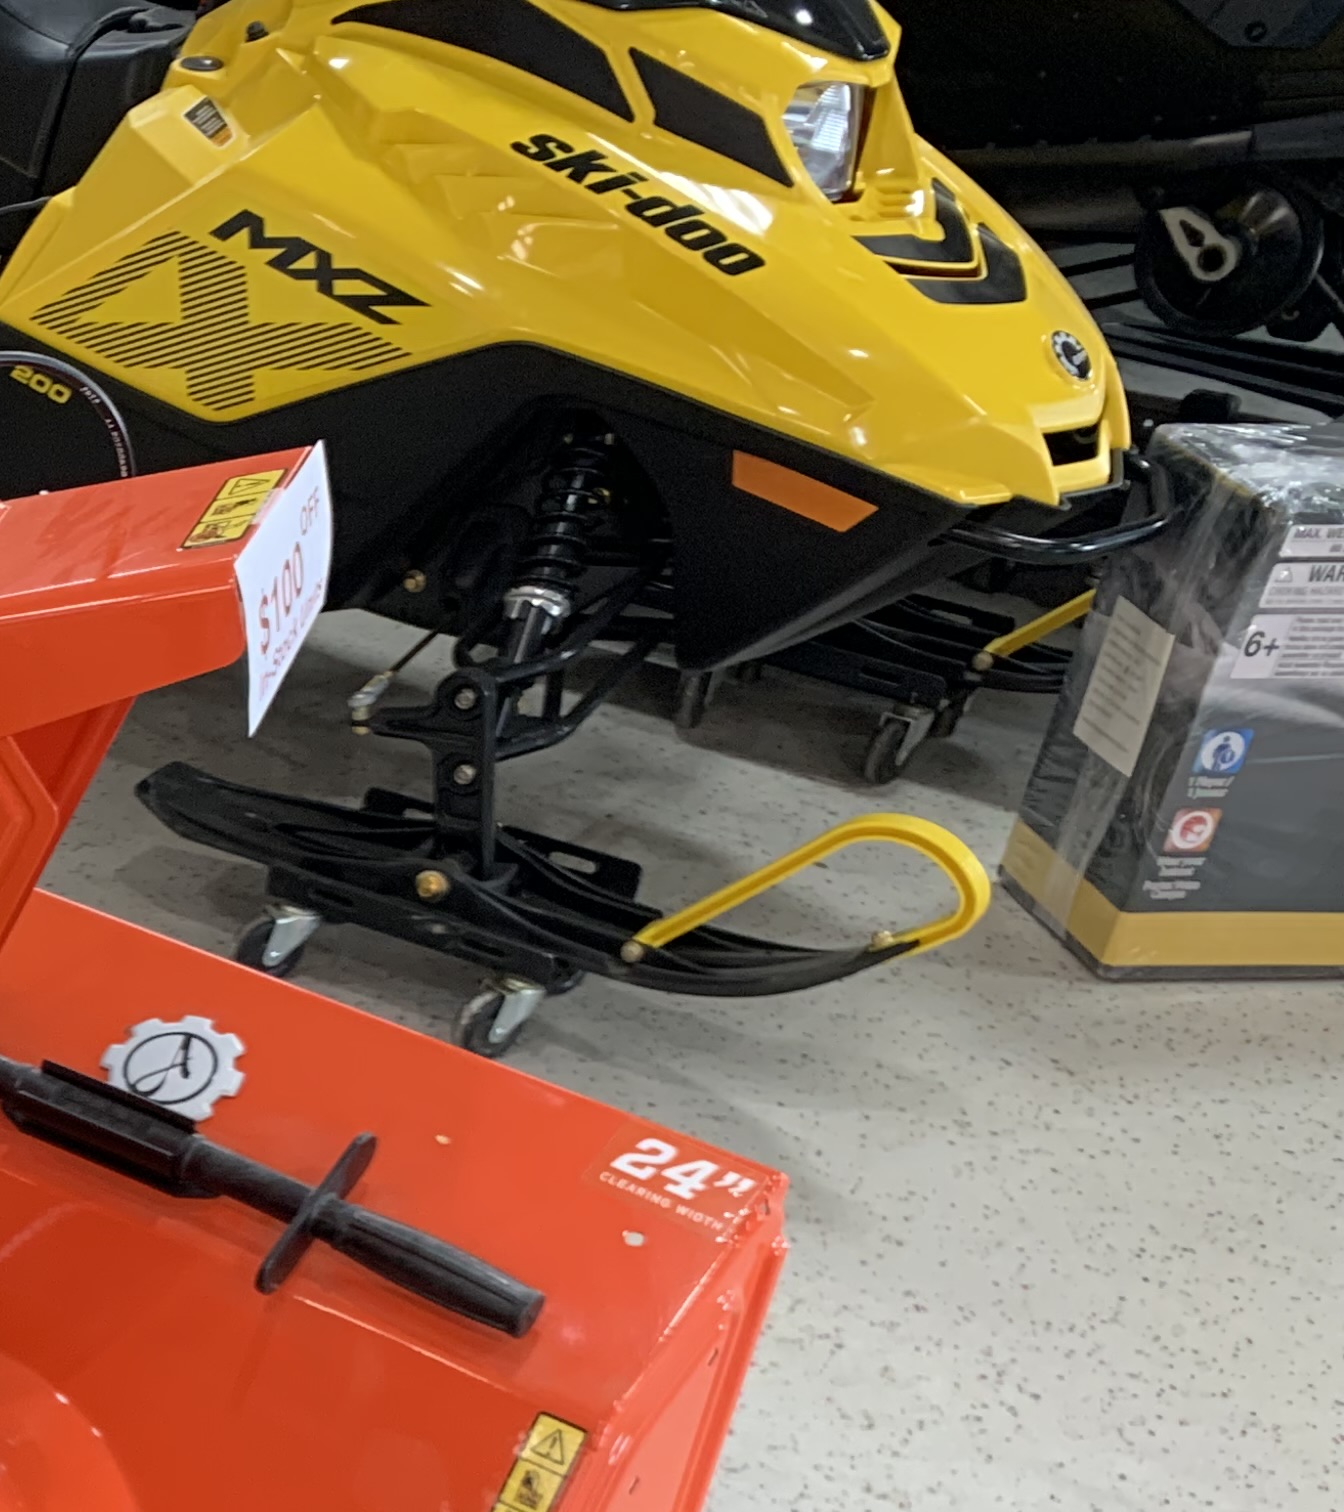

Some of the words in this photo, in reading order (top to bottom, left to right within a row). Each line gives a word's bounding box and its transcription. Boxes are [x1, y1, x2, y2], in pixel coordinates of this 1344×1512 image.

[209, 209, 432, 325] MXZ
[10, 365, 72, 404] 200
[258, 540, 305, 659] $100
[300, 486, 320, 536] OFF
[1244, 631, 1280, 657] 6+
[599, 1171, 672, 1209] CLEARING
[675, 1203, 724, 1232] WIDTH
